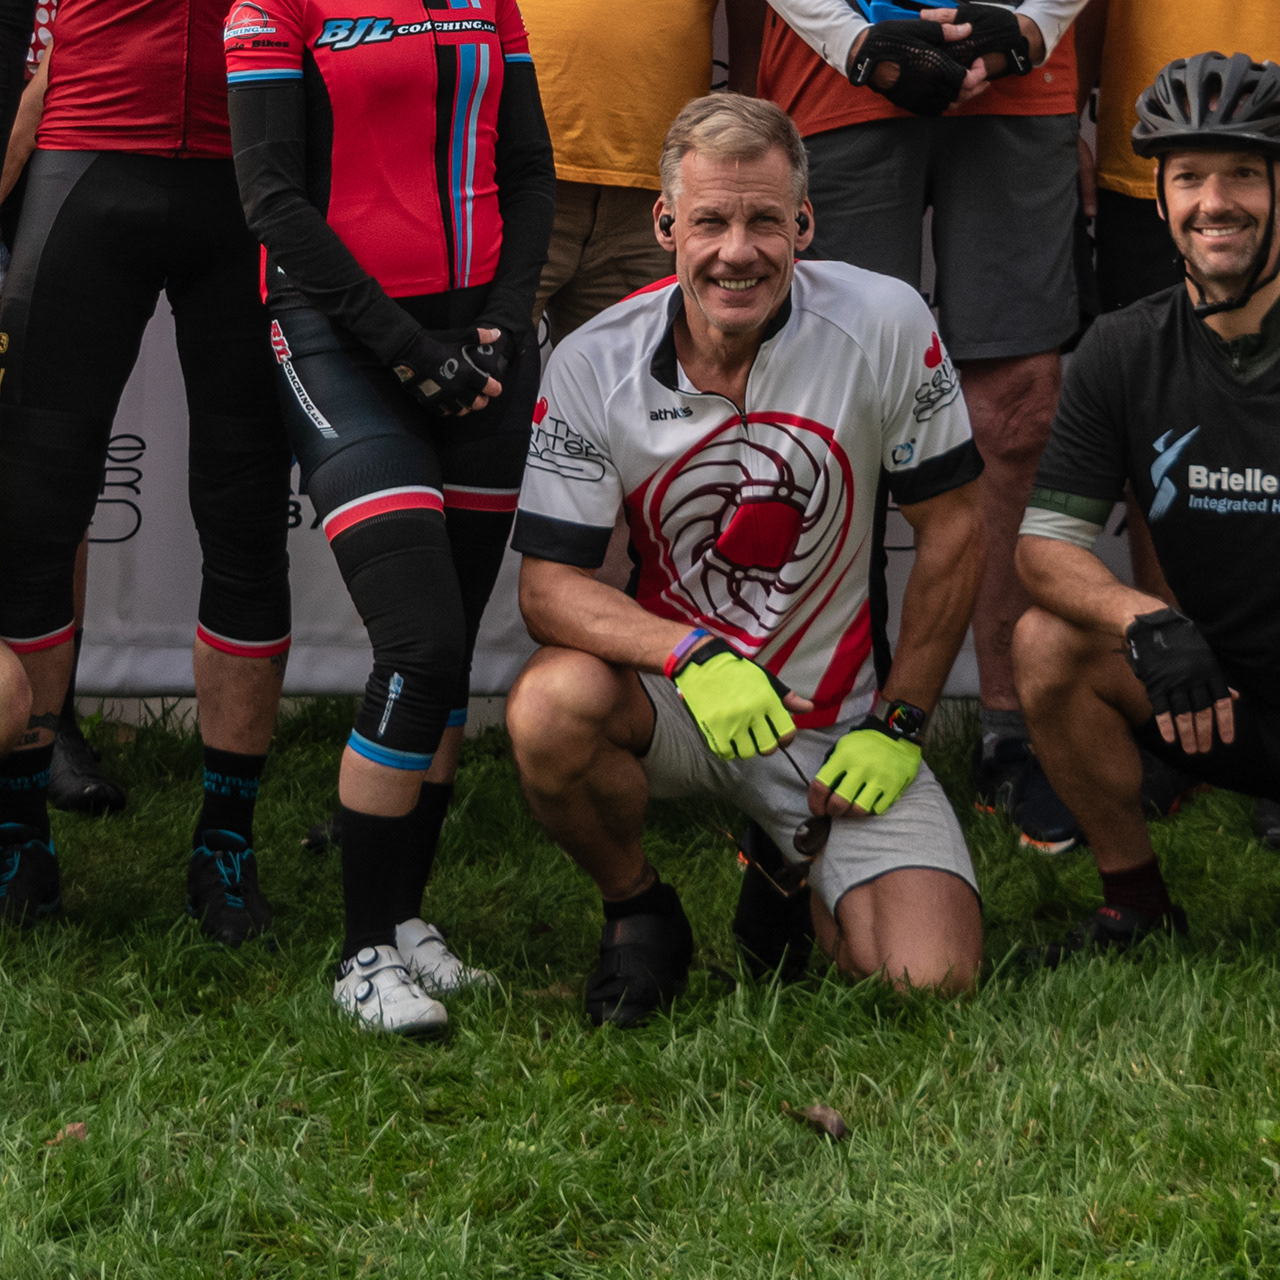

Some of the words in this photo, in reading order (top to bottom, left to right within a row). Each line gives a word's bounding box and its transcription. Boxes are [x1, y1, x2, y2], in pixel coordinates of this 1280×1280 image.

[318, 17, 394, 50] BJL
[1188, 464, 1279, 493] Brielle
[1188, 494, 1269, 513] Integrated
